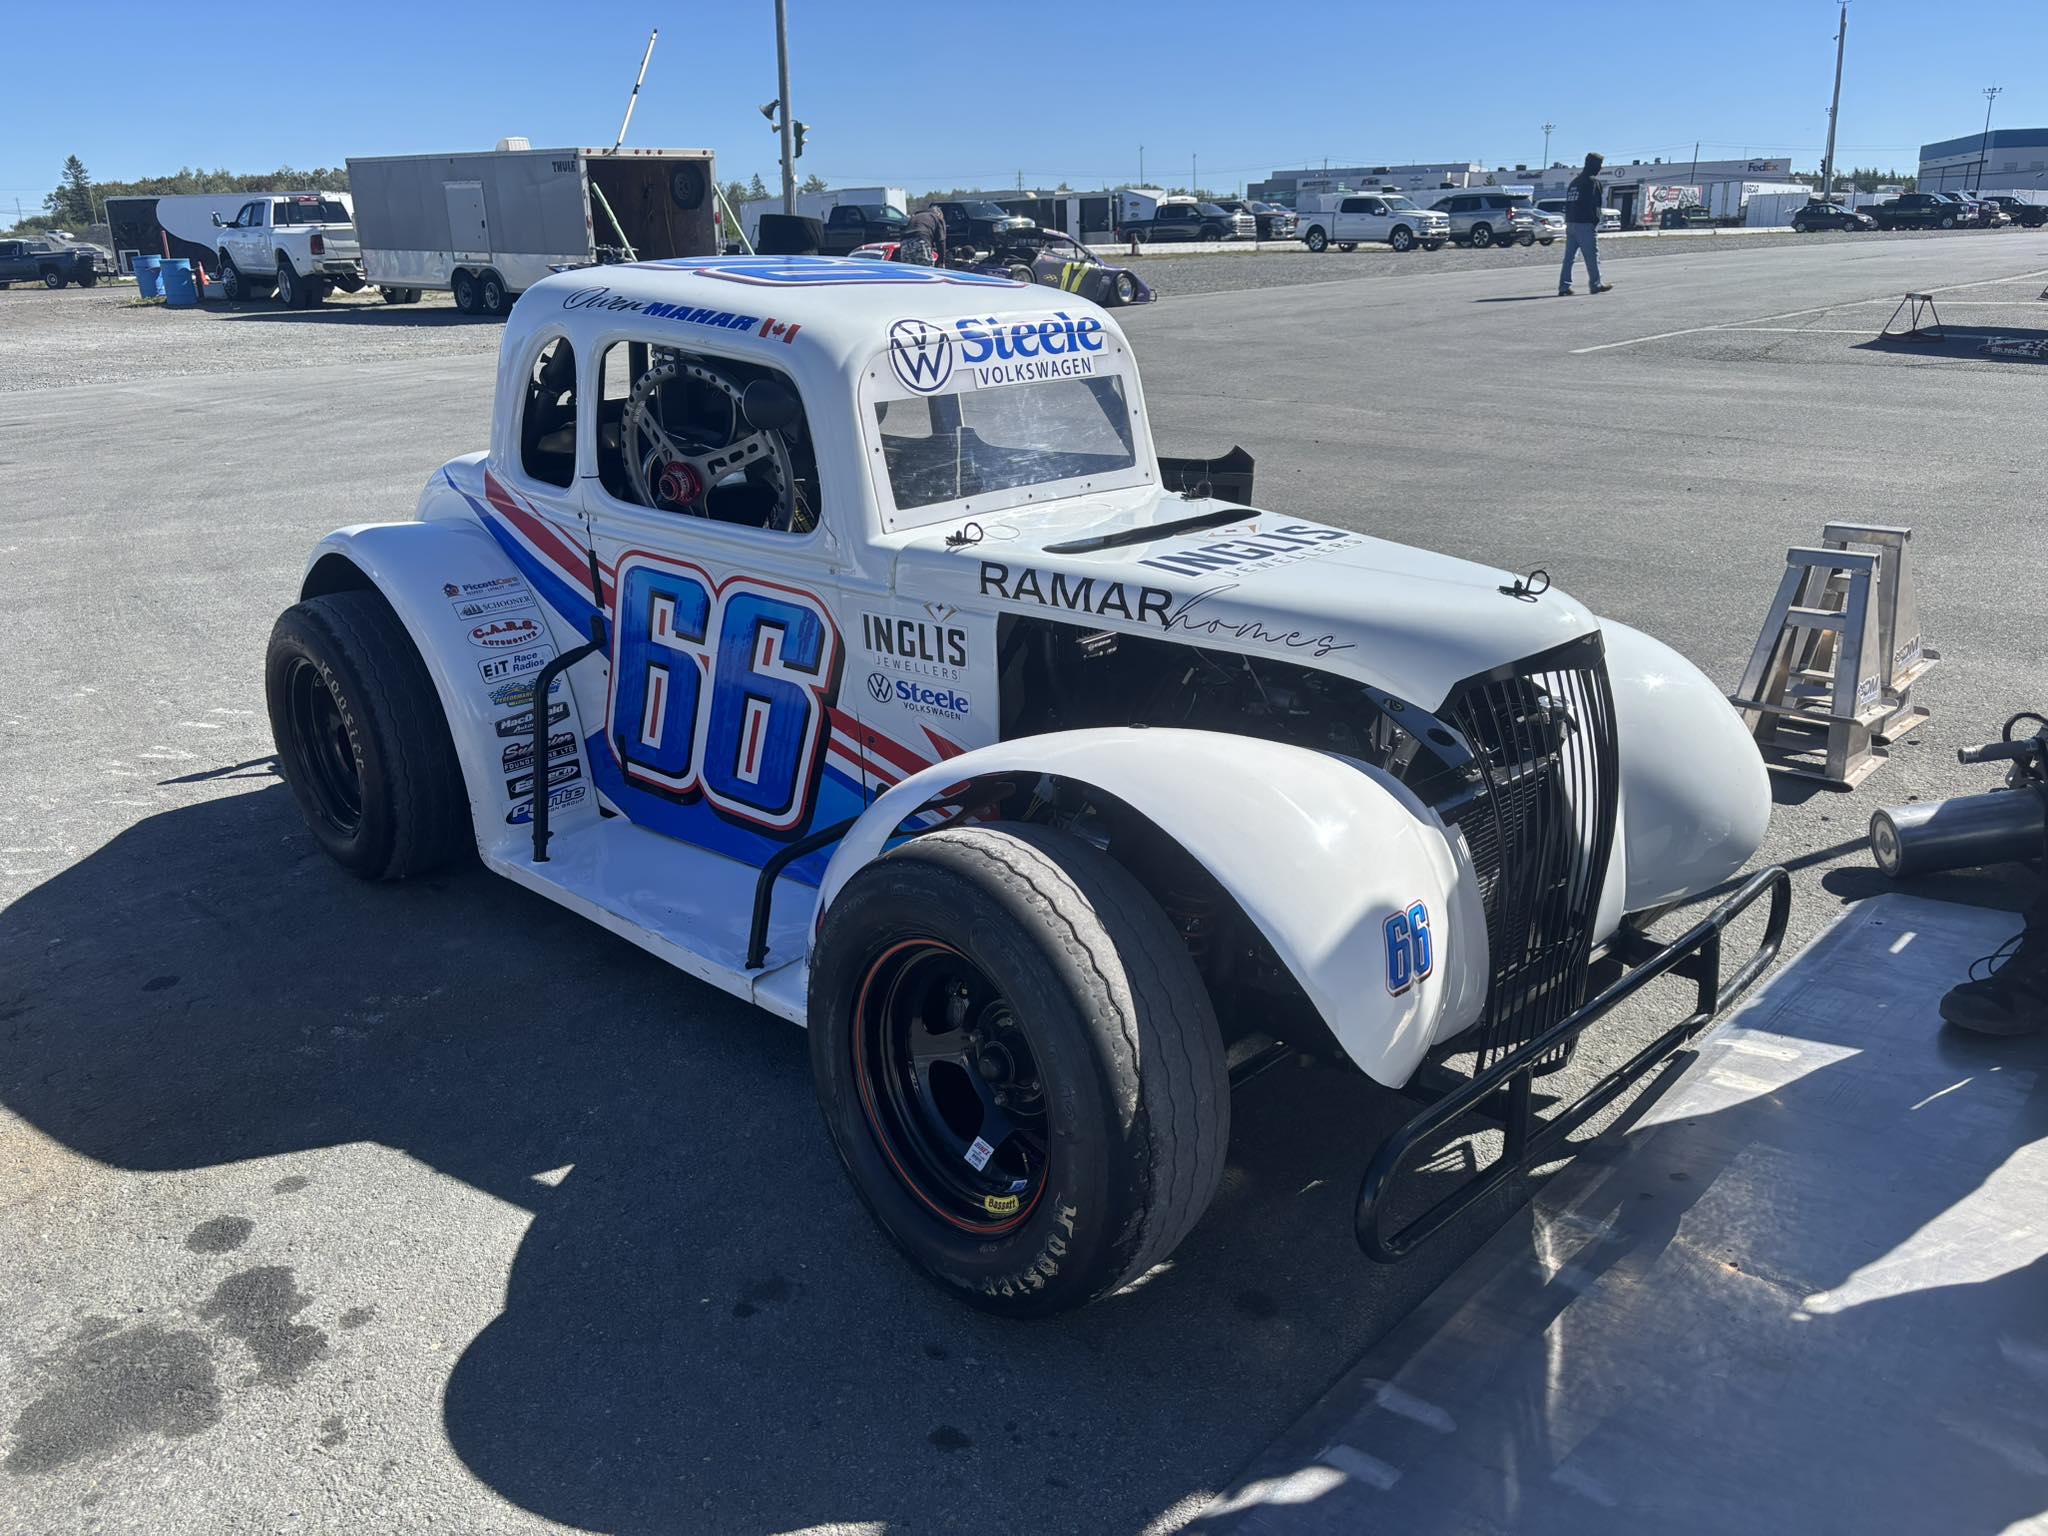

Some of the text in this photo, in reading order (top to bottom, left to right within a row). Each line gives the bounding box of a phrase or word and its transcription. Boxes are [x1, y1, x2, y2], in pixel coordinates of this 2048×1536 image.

[1748, 162, 1778, 172] FedEx
[1060, 262, 1091, 293] 17
[642, 302, 759, 331] MAHAR
[955, 312, 1103, 363] Steele
[979, 357, 1092, 385] VOLKSWAGEN
[1138, 525, 1352, 577] INGLIS
[1222, 538, 1364, 579] JEWELLERS
[483, 595, 531, 610] SCHOONER
[980, 561, 1173, 627] RAMAR
[482, 631, 537, 646] AUTOMOTIVE
[862, 614, 966, 667] INGLIS
[483, 660, 509, 678] EiT
[513, 652, 538, 663] Race
[512, 659, 545, 673] Radios
[876, 655, 958, 680] JEWELLERS
[606, 551, 838, 832] 66
[895, 680, 969, 713] Steele
[501, 704, 564, 730] MacDald
[903, 702, 961, 721] VOLKSWAGEN
[1382, 899, 1434, 998] 66
